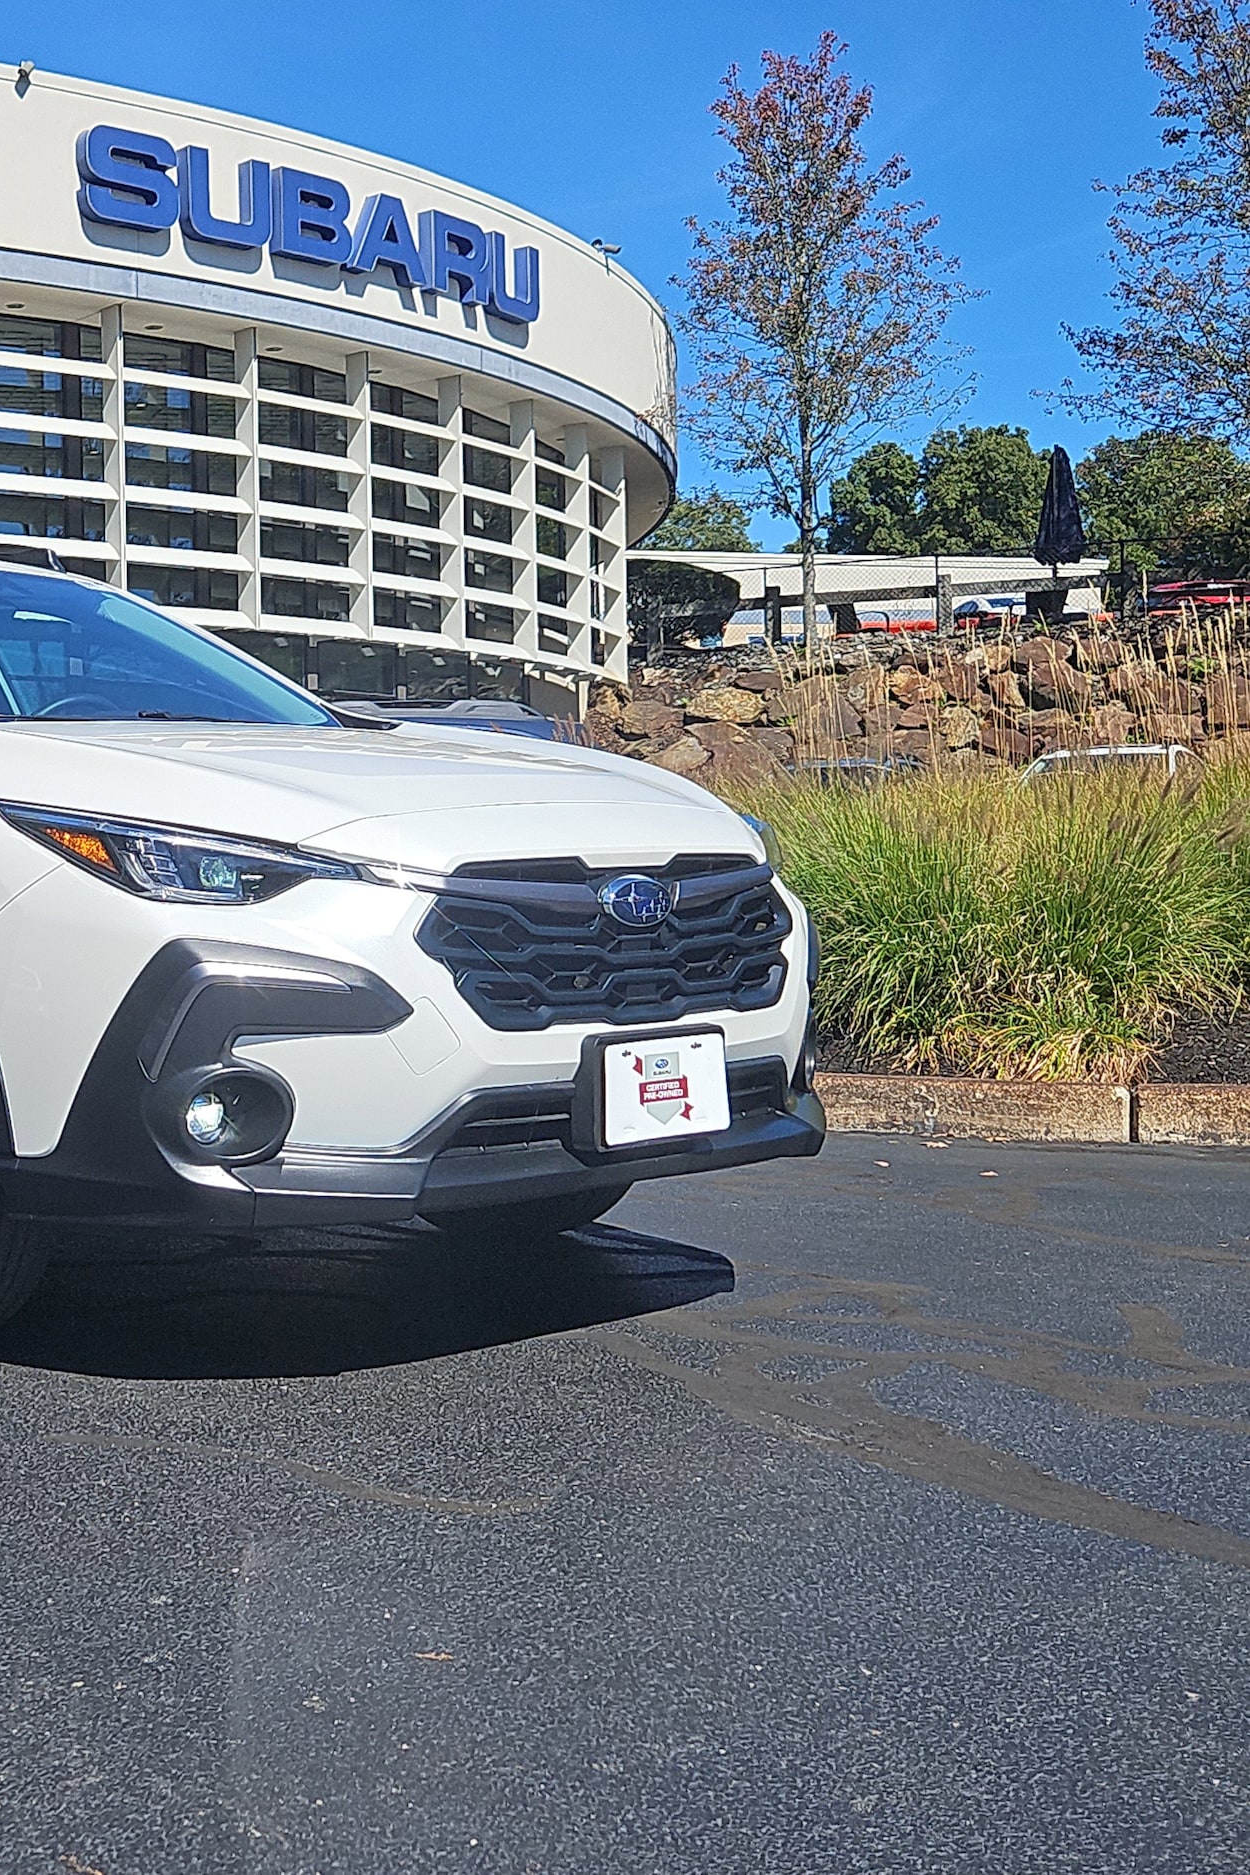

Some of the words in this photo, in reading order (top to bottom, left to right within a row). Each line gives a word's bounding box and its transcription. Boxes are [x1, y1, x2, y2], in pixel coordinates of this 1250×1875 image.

[76, 123, 540, 324] SUBARU
[646, 1081, 680, 1092] CERTIFIED
[643, 1089, 683, 1100] PRE-OWNED
